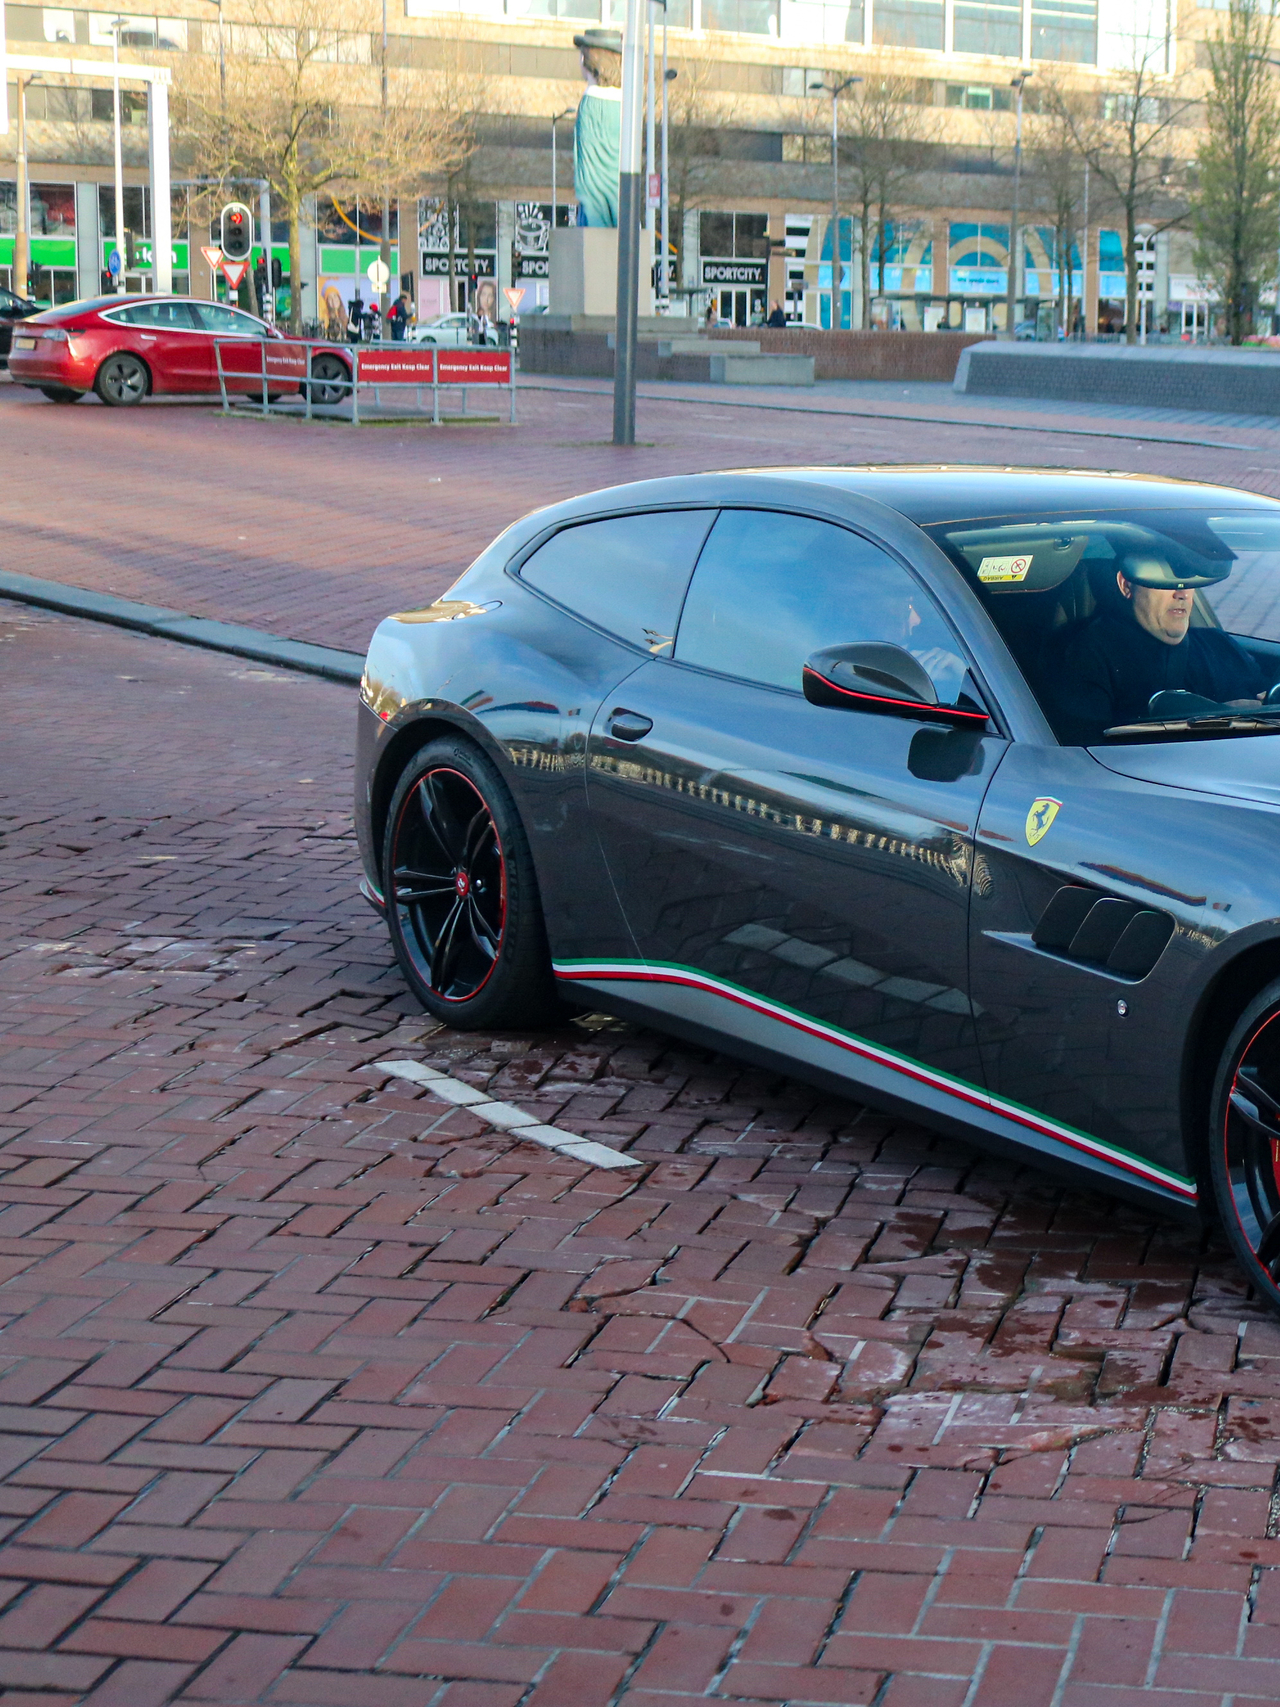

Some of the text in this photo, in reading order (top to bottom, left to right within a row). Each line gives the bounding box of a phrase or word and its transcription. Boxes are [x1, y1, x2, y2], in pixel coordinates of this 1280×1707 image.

[361, 362, 430, 372] Emergency Exit Keep Clear
[439, 363, 508, 373] Emergency Exit Keep Clear
